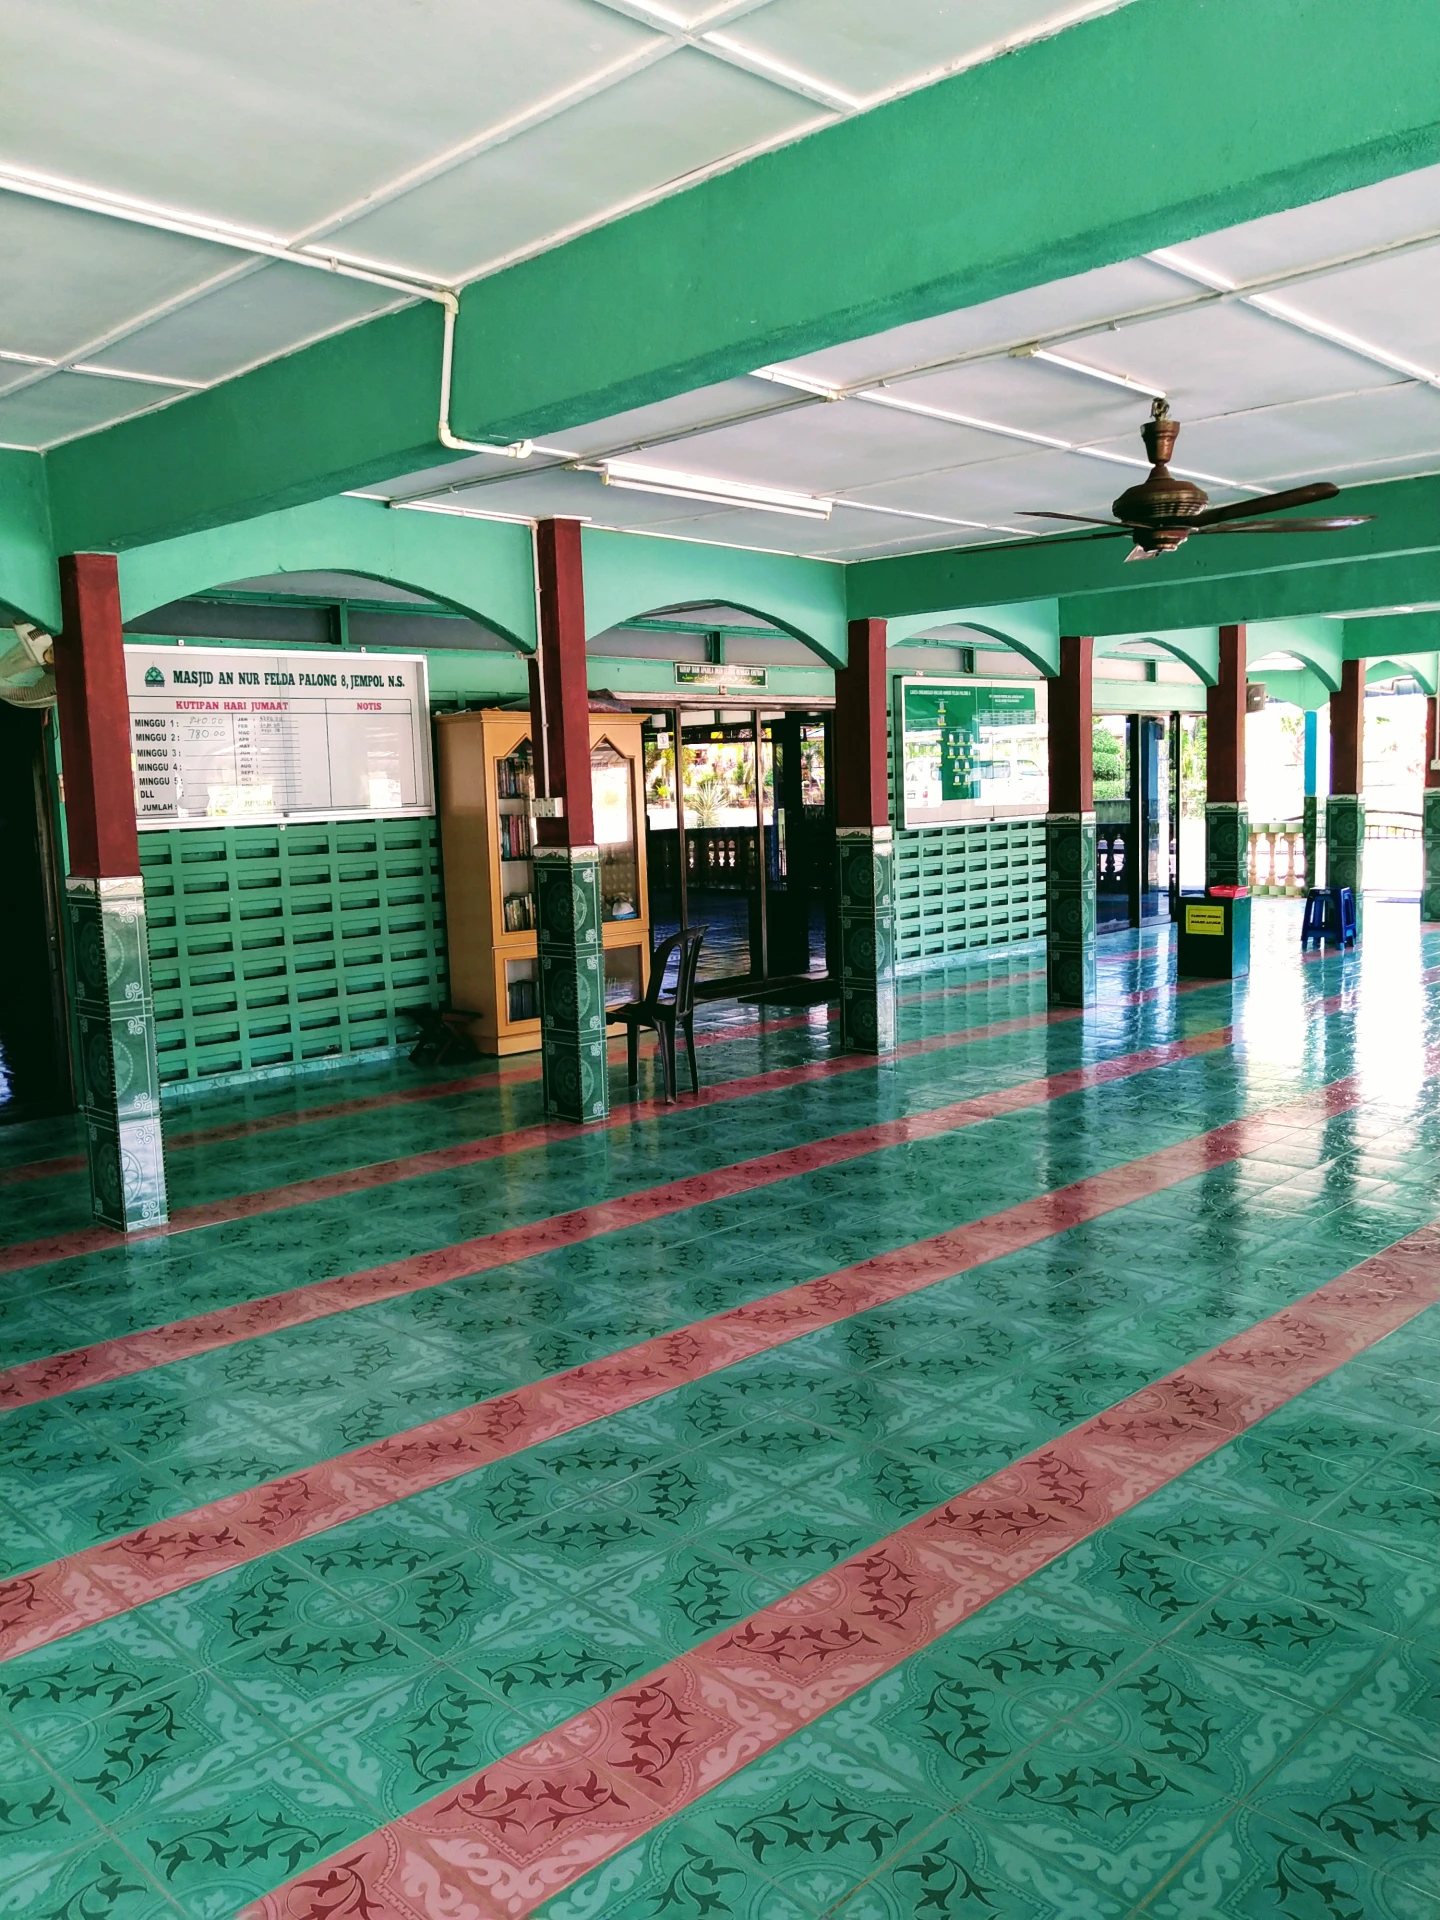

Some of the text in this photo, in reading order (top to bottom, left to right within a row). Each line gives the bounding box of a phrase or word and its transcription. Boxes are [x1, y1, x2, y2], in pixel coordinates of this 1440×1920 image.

[173, 670, 214, 687] MASJID
[218, 672, 234, 685] AN
[238, 672, 260, 685] NUR
[264, 672, 295, 685] FELDA
[299, 673, 337, 686] PALONG
[350, 675, 384, 689] JEMPOL
[388, 675, 405, 687] N.S.
[176, 701, 288, 712] KUTIPAN HARI JUMAAT
[356, 702, 382, 710] NOTIS
[134, 719, 166, 728] MINGGU
[135, 733, 167, 741] MINGGU
[136, 749, 168, 757] MINGGU
[138, 763, 169, 771] MINGGU
[139, 777, 170, 785] MINGGU
[140, 790, 154, 798] DLL
